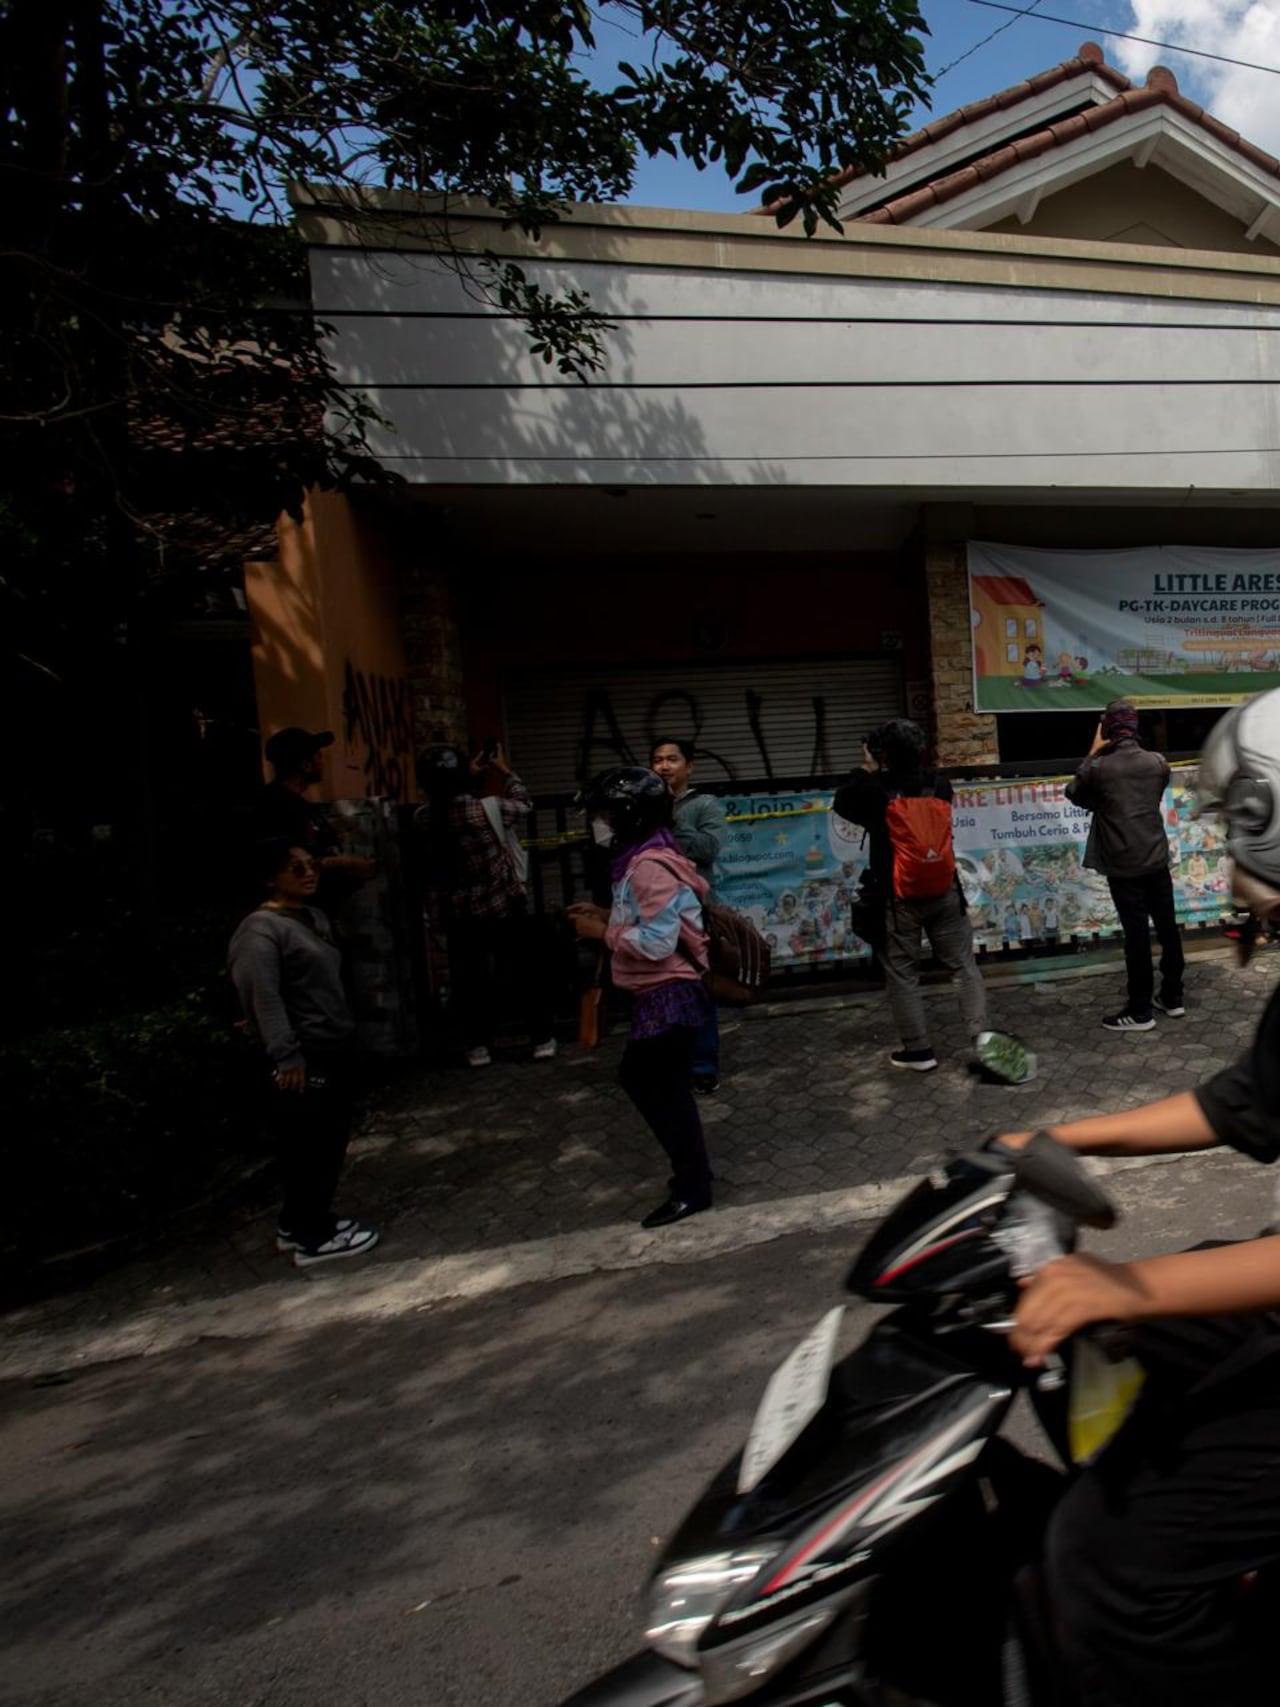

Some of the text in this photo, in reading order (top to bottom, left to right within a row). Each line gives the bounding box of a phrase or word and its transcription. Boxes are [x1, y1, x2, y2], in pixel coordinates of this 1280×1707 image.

[1154, 573, 1227, 591] LITTLE
[1119, 598, 1238, 612] PG-TK-DAYCARE
[994, 783, 1066, 806] LITTLE
[1011, 809, 1061, 822] Bersama
[990, 825, 1037, 840] Tumbuh
[1038, 823, 1069, 837] Ceria
[1071, 822, 1081, 834] &
